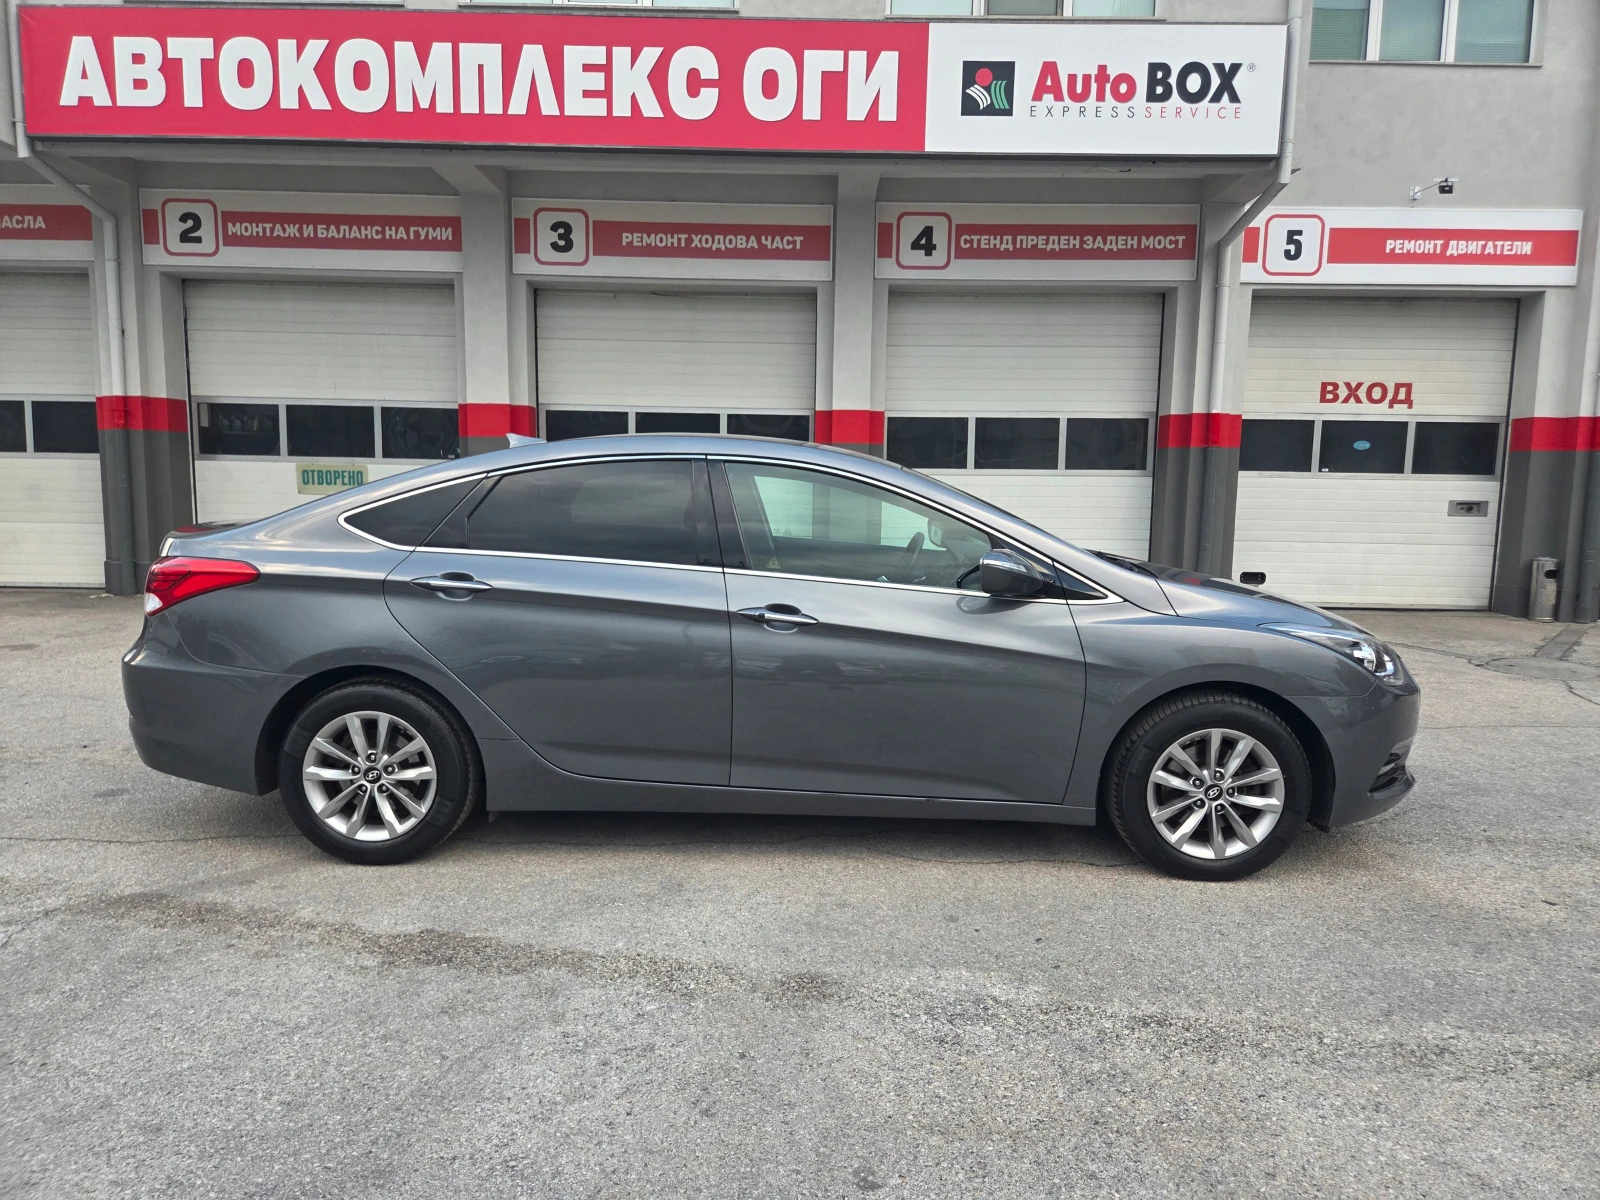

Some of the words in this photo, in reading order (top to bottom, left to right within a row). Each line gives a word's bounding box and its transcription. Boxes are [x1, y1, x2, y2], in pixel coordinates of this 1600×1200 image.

[60, 36, 719, 120] АВТОКОМПЛЕКС
[743, 47, 898, 121] ОГИ
[1031, 61, 1137, 104] Auto
[1145, 62, 1242, 104] BOX
[0, 215, 46, 229] АСЛА
[179, 212, 203, 243] 2
[228, 222, 300, 237] МОНТАЖ
[303, 224, 314, 238] И
[317, 225, 382, 239] БАЛАНС
[385, 226, 407, 240] НА
[409, 226, 452, 241] ГУМИ
[550, 221, 574, 253] 3
[622, 232, 688, 247] РЕМОНТ
[691, 234, 759, 251] ХОДОВА
[761, 236, 804, 250] ЧАСТ
[911, 226, 937, 256] 4
[960, 235, 1014, 251] СТЕНД
[1016, 235, 1080, 251] ПРЕДЕН
[1083, 236, 1138, 251] ЗАДЕН
[1141, 236, 1185, 250] МОСТ
[1284, 230, 1303, 260] 5
[1385, 239, 1444, 255] РЕМОНТ
[1446, 240, 1533, 257] ДВИГАТЕЛИ
[1319, 381, 1414, 410] ВХОД
[302, 469, 364, 486] ОТВОРЕНО
